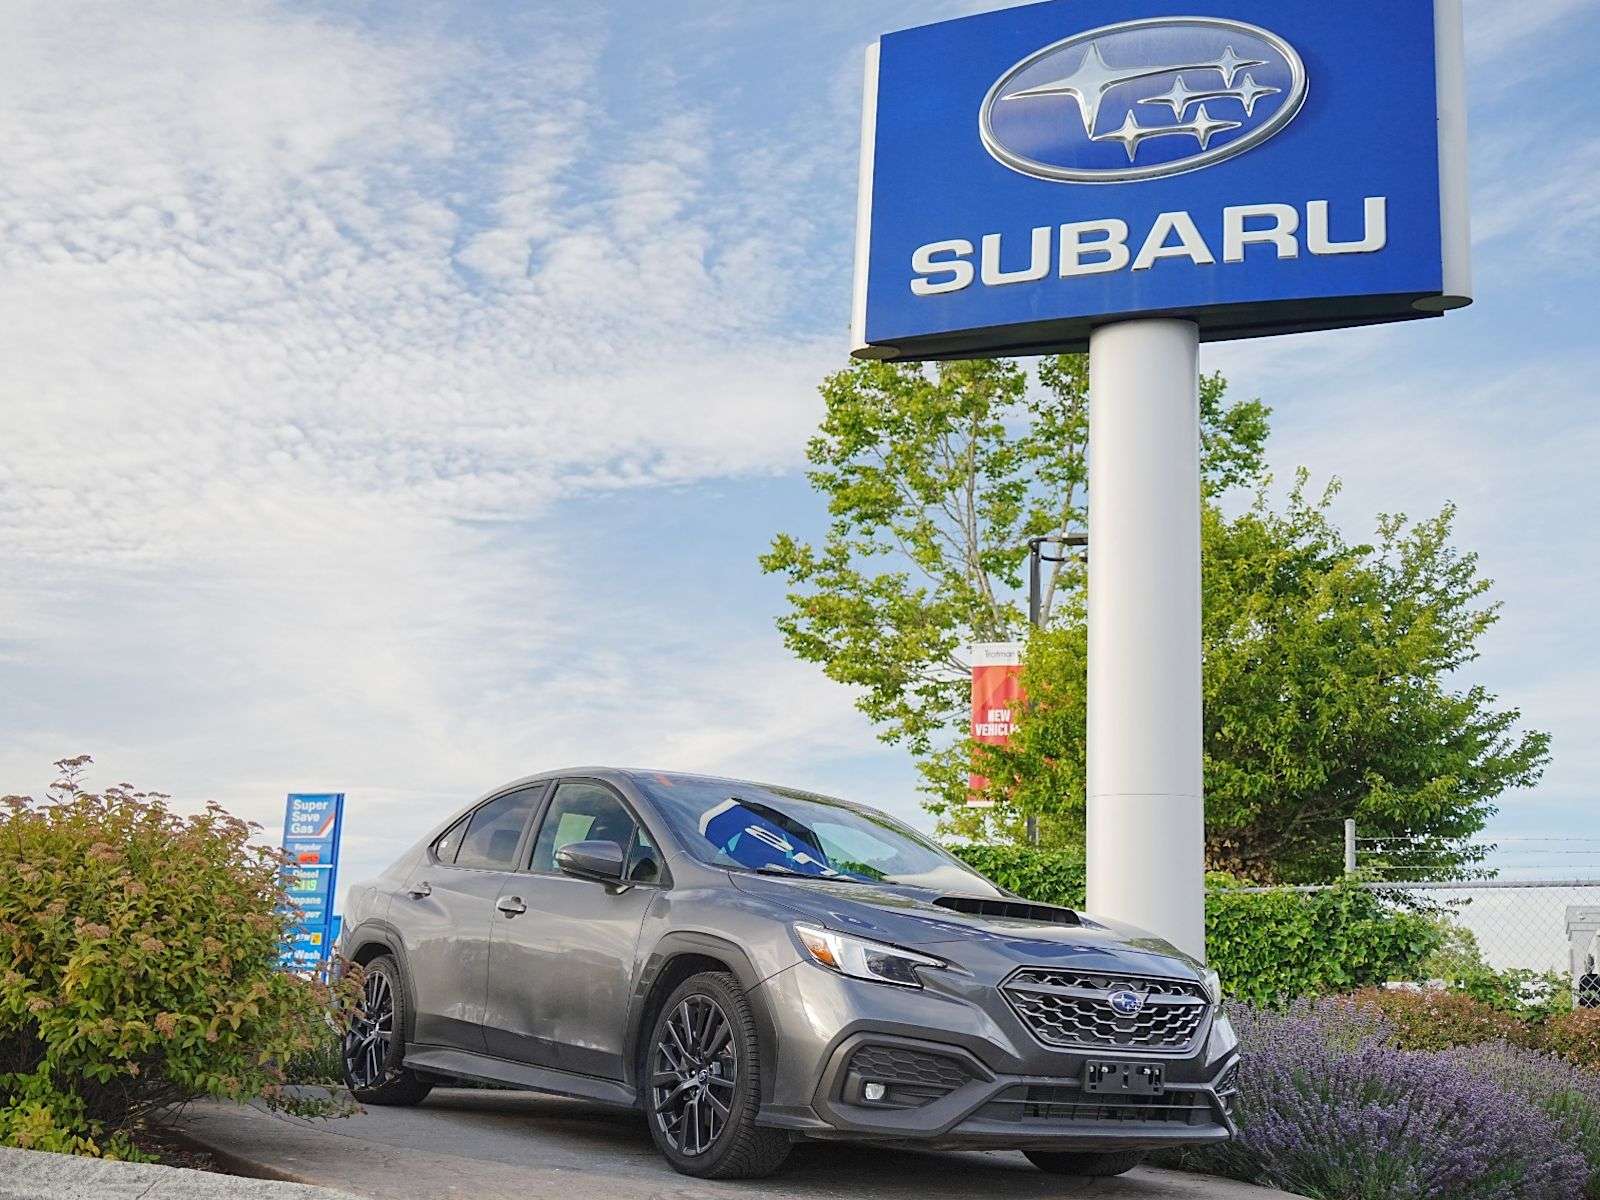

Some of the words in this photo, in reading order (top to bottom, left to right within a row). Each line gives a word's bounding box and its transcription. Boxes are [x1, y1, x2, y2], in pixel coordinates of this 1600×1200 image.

[910, 196, 1387, 296] SUBARU
[988, 709, 1011, 722] NEW
[292, 799, 328, 813] Super
[292, 811, 320, 822] Save
[290, 822, 313, 834] Gas
